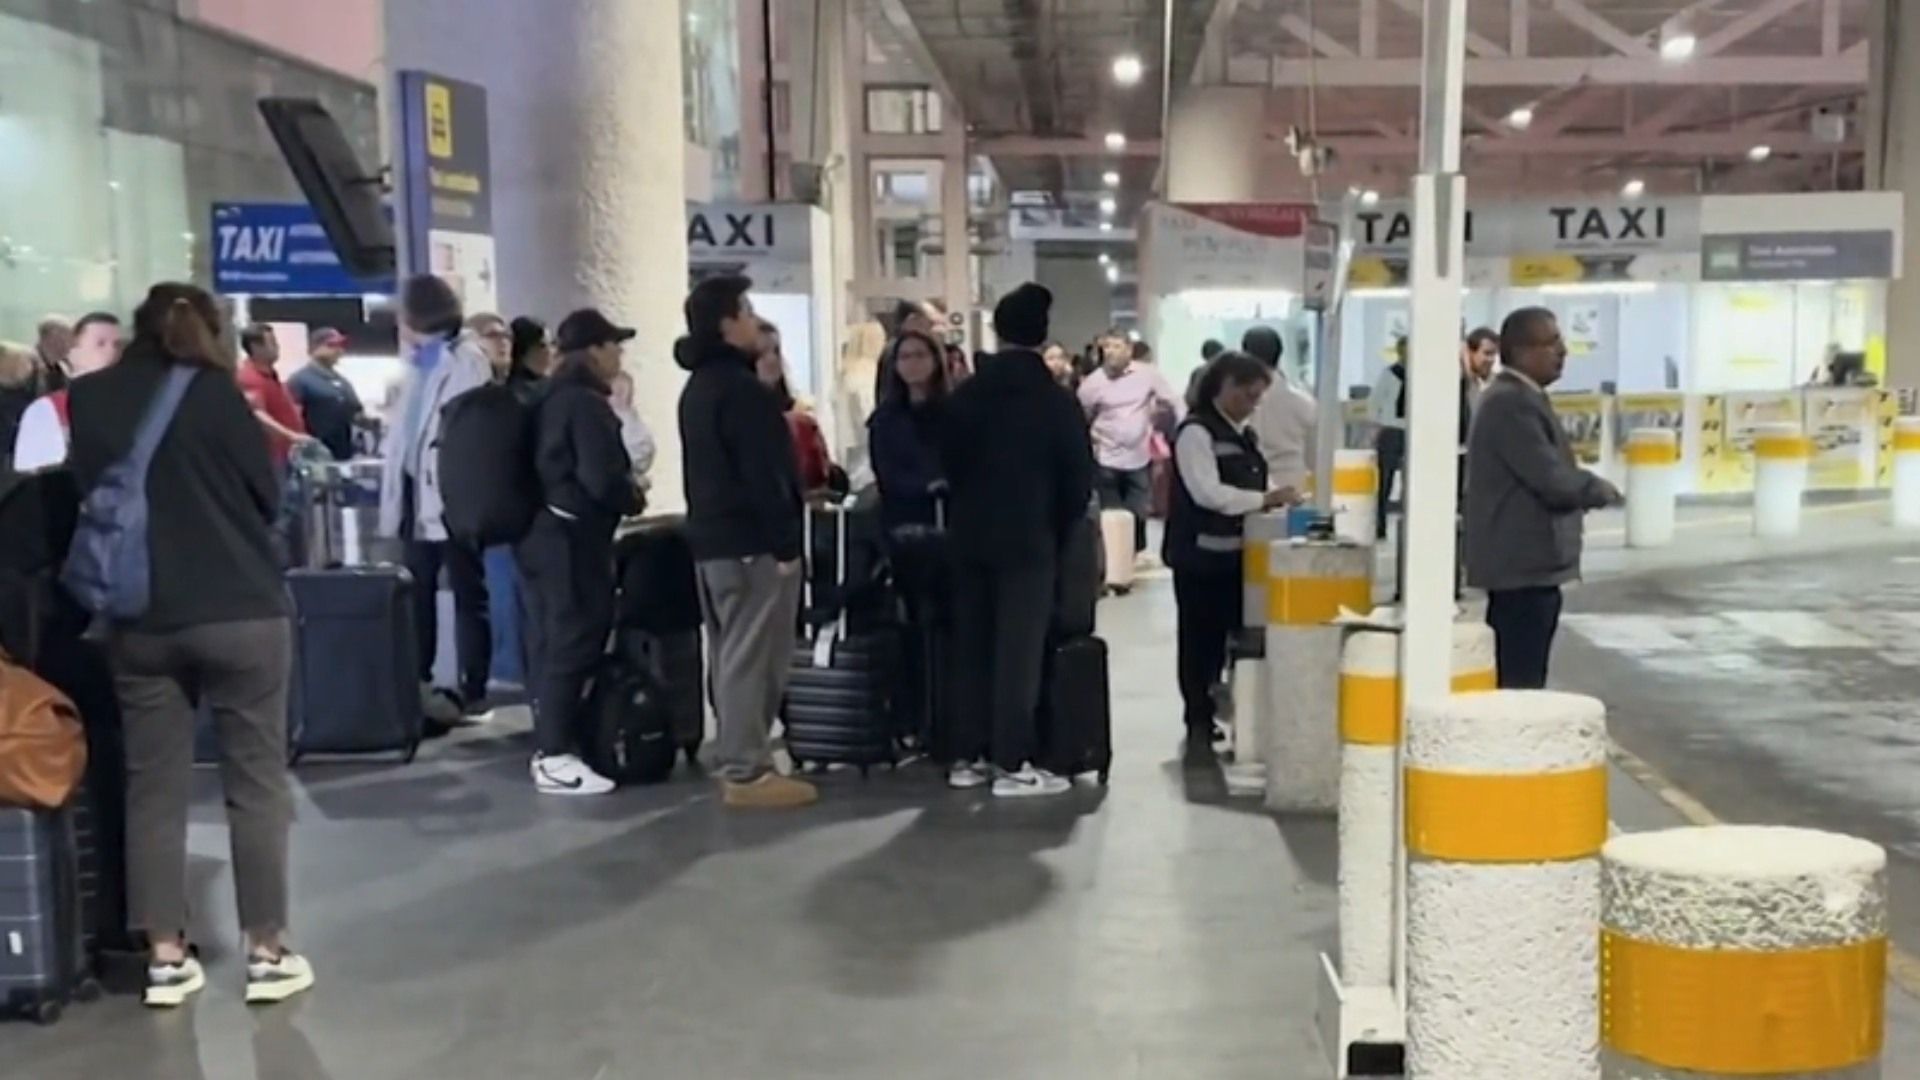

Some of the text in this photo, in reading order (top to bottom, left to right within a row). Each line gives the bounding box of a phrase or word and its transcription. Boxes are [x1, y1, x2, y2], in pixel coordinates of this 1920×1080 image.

[687, 213, 775, 247] AXI
[1356, 211, 1473, 244] TAI
[1550, 206, 1666, 240] TAXI
[218, 225, 287, 262] TAXI
